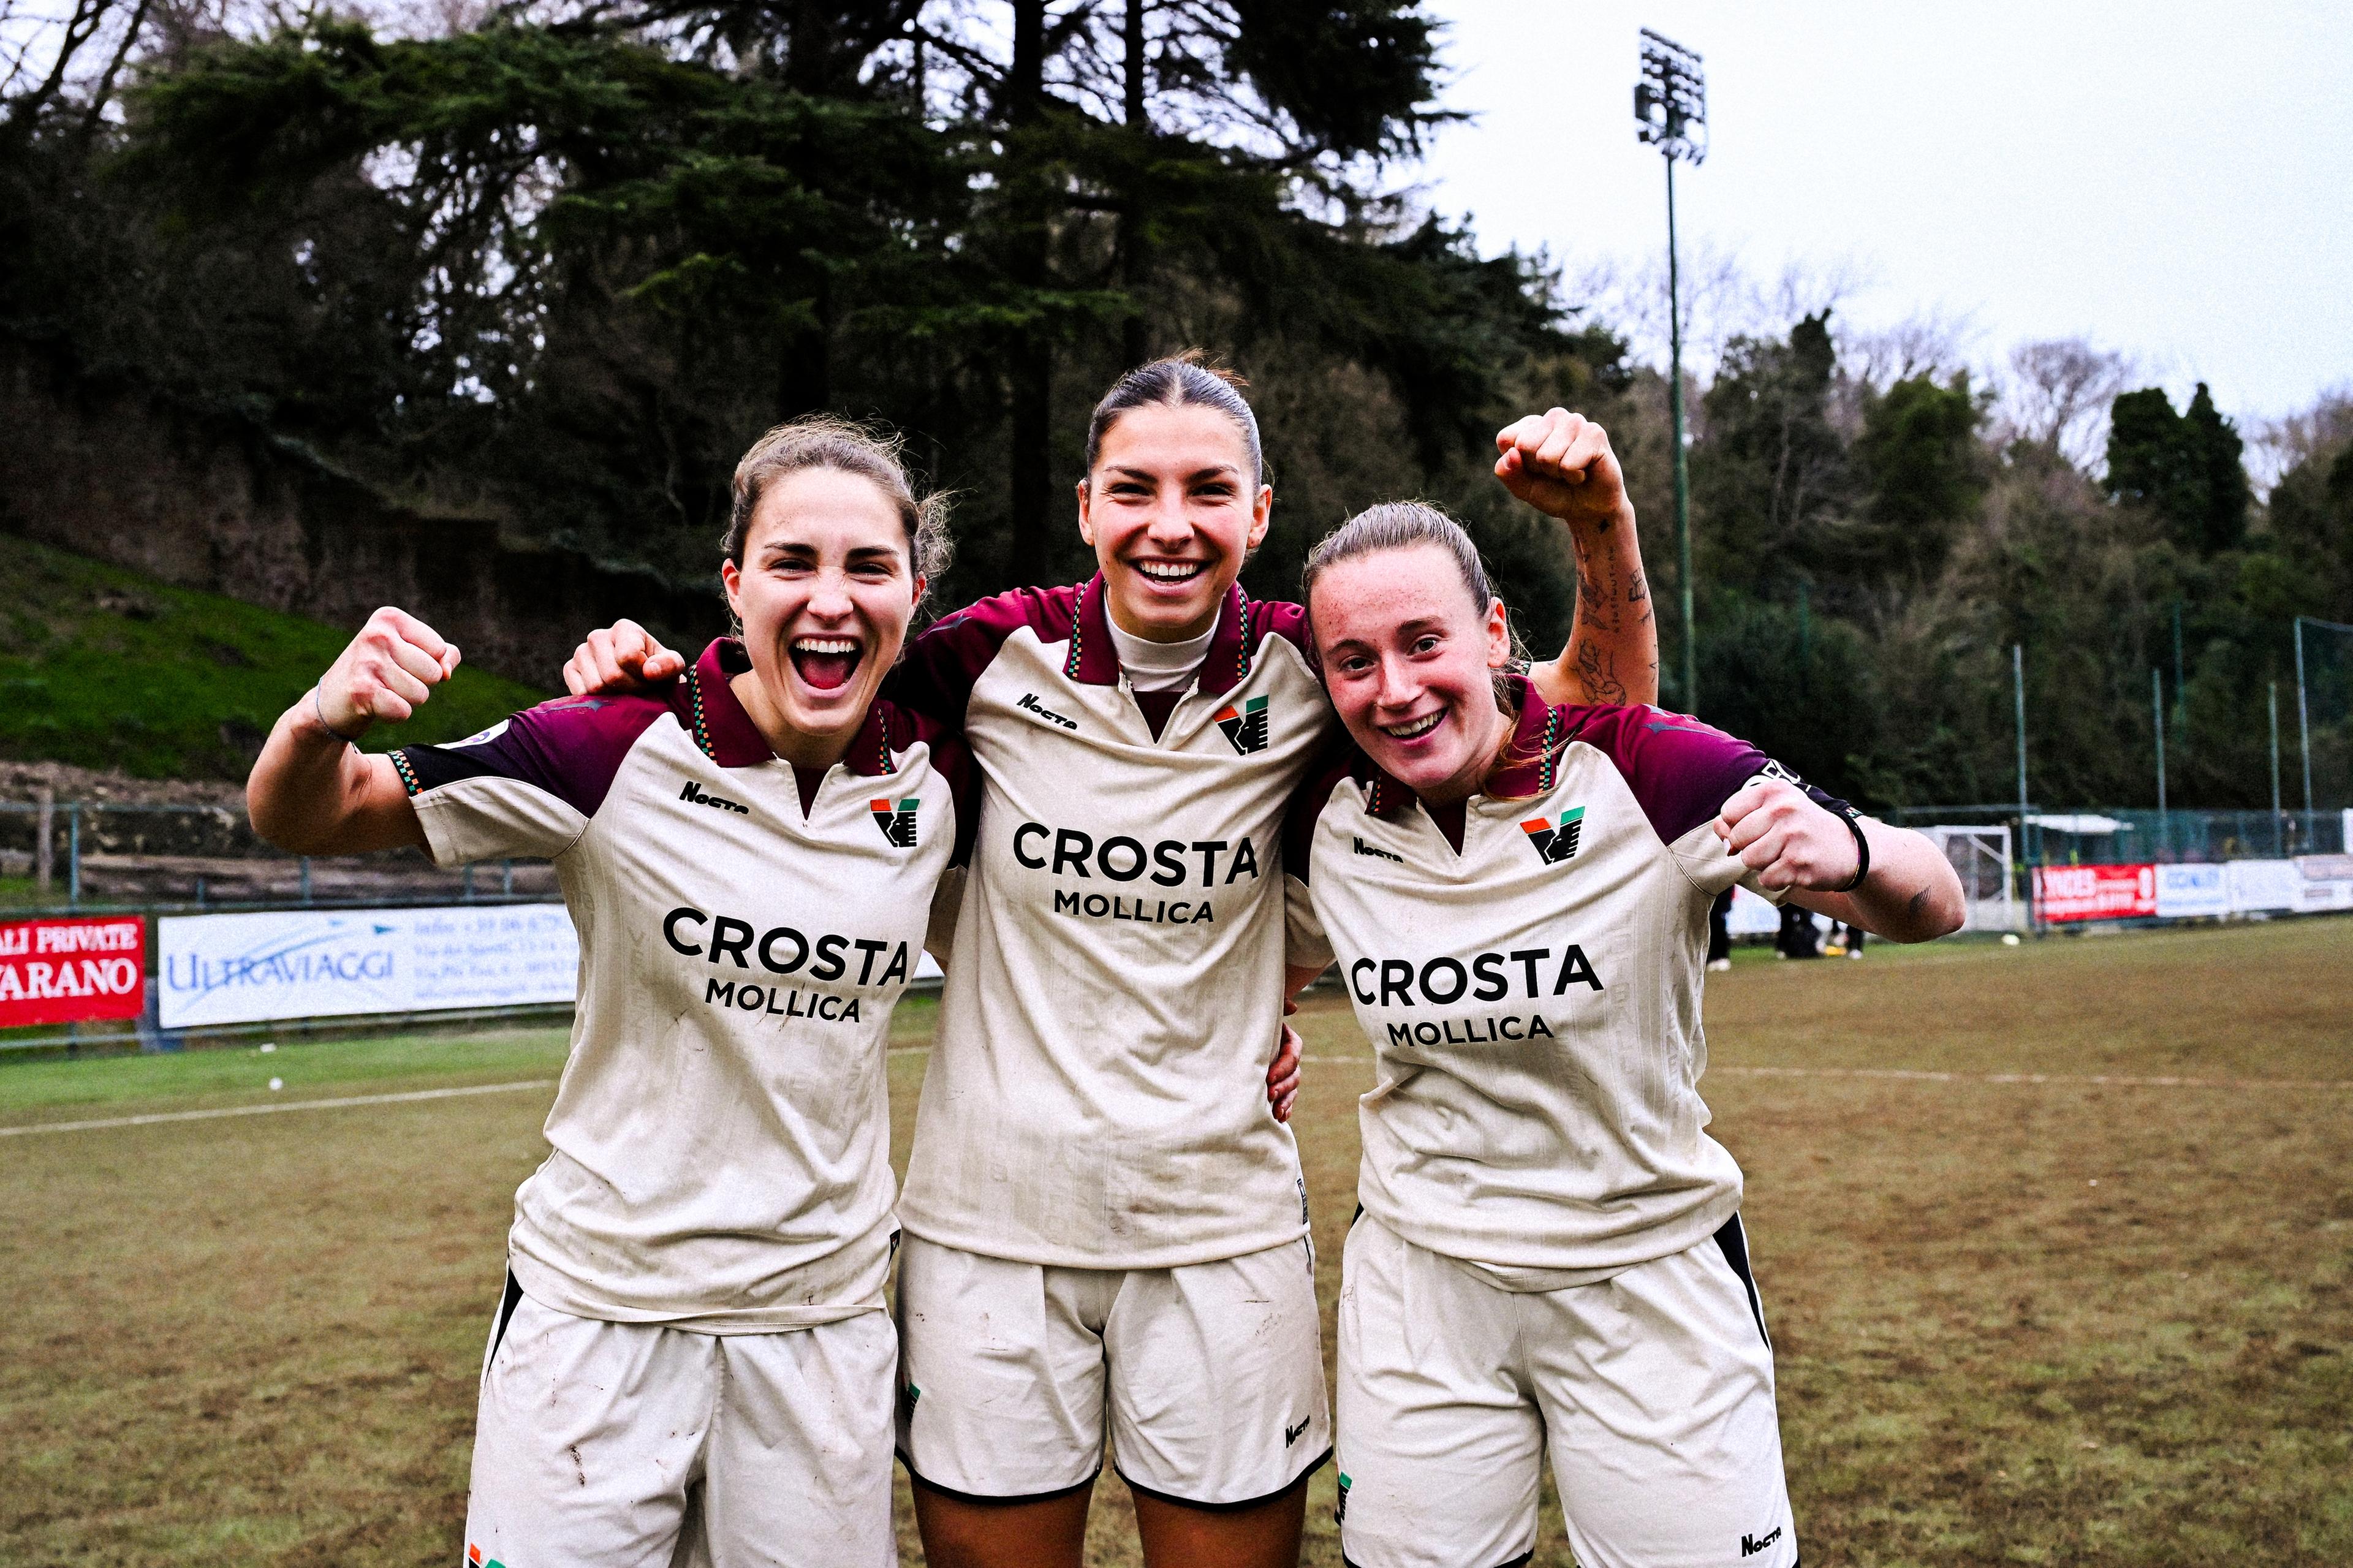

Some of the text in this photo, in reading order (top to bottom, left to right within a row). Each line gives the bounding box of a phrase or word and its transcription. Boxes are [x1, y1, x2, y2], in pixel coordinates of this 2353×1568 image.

[1013, 822, 1259, 887] CROSTA
[1054, 889, 1214, 924] MOLLICA
[36, 923, 138, 953] PRIVATE
[663, 907, 907, 986] CROSTA
[0, 958, 137, 1001] ARANO
[1351, 944, 1604, 1006] CROSTA
[705, 978, 860, 1023] MOLLICA
[1387, 1015, 1555, 1047] MOLLICA
